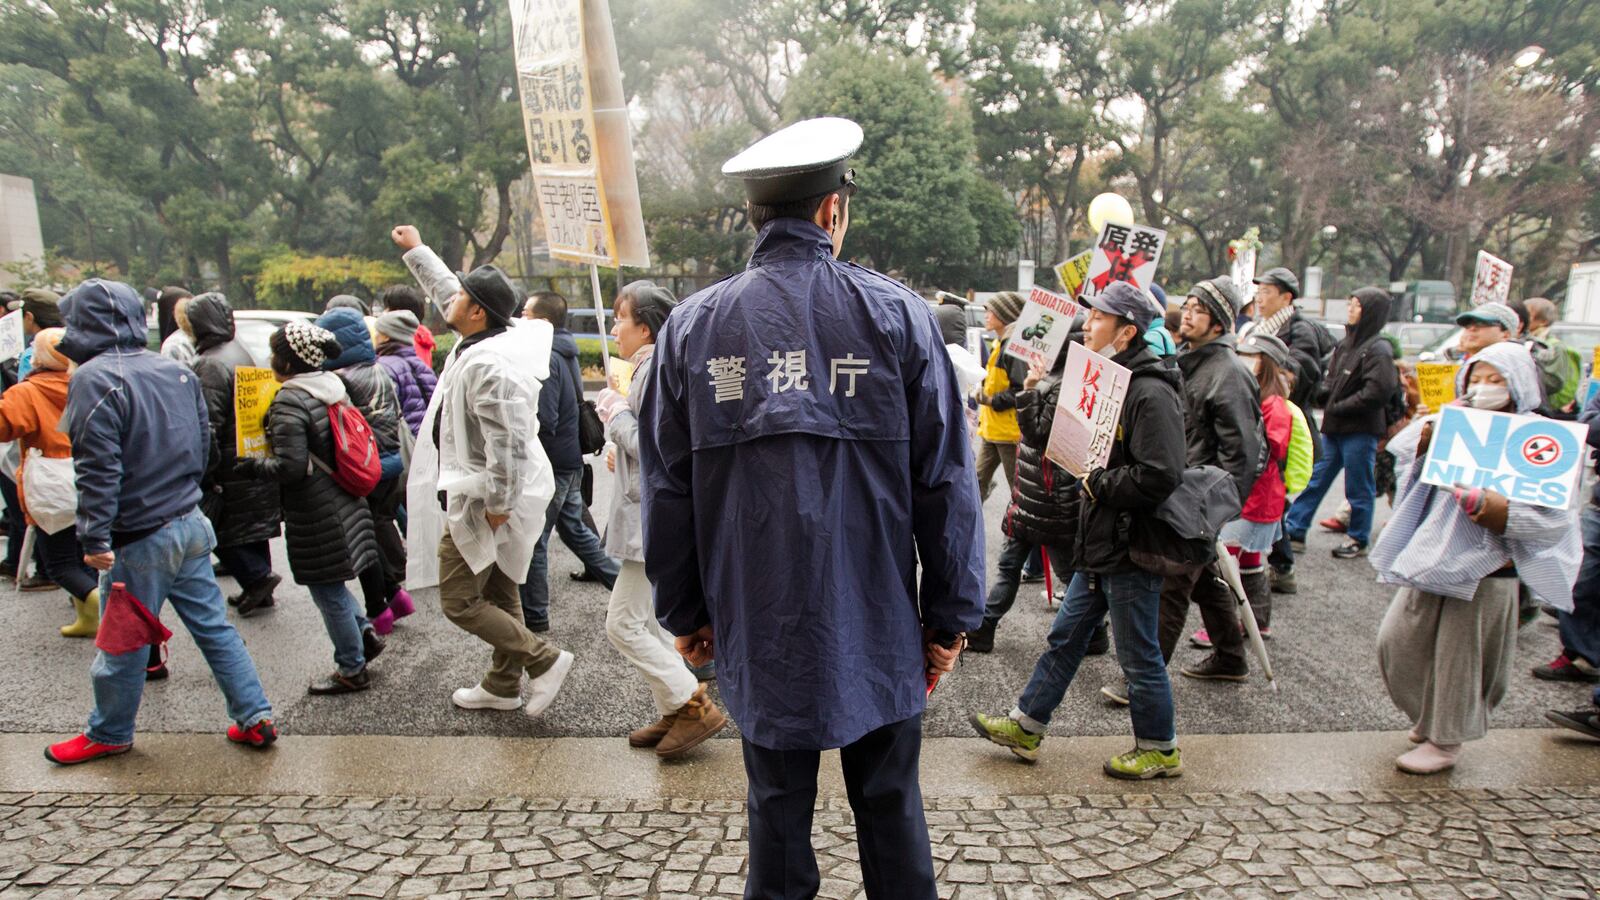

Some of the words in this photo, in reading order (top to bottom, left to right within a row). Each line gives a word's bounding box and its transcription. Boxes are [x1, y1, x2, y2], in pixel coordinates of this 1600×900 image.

[529, 118, 592, 164] 足りる
[540, 180, 602, 223] 宇都宮
[1099, 223, 1159, 262] 原発
[1030, 288, 1078, 318] RADIATION
[1031, 338, 1051, 353] YOU
[237, 369, 273, 384] Nuclear
[706, 349, 871, 404] 警視庁
[1417, 365, 1453, 376] Nuclear
[1420, 378, 1440, 387] Free
[238, 385, 257, 397] Free
[239, 398, 258, 410] Now
[1074, 358, 1104, 420] 反対
[1423, 388, 1442, 398] Now
[1431, 408, 1580, 480] NO
[1426, 461, 1569, 507] NUKES
